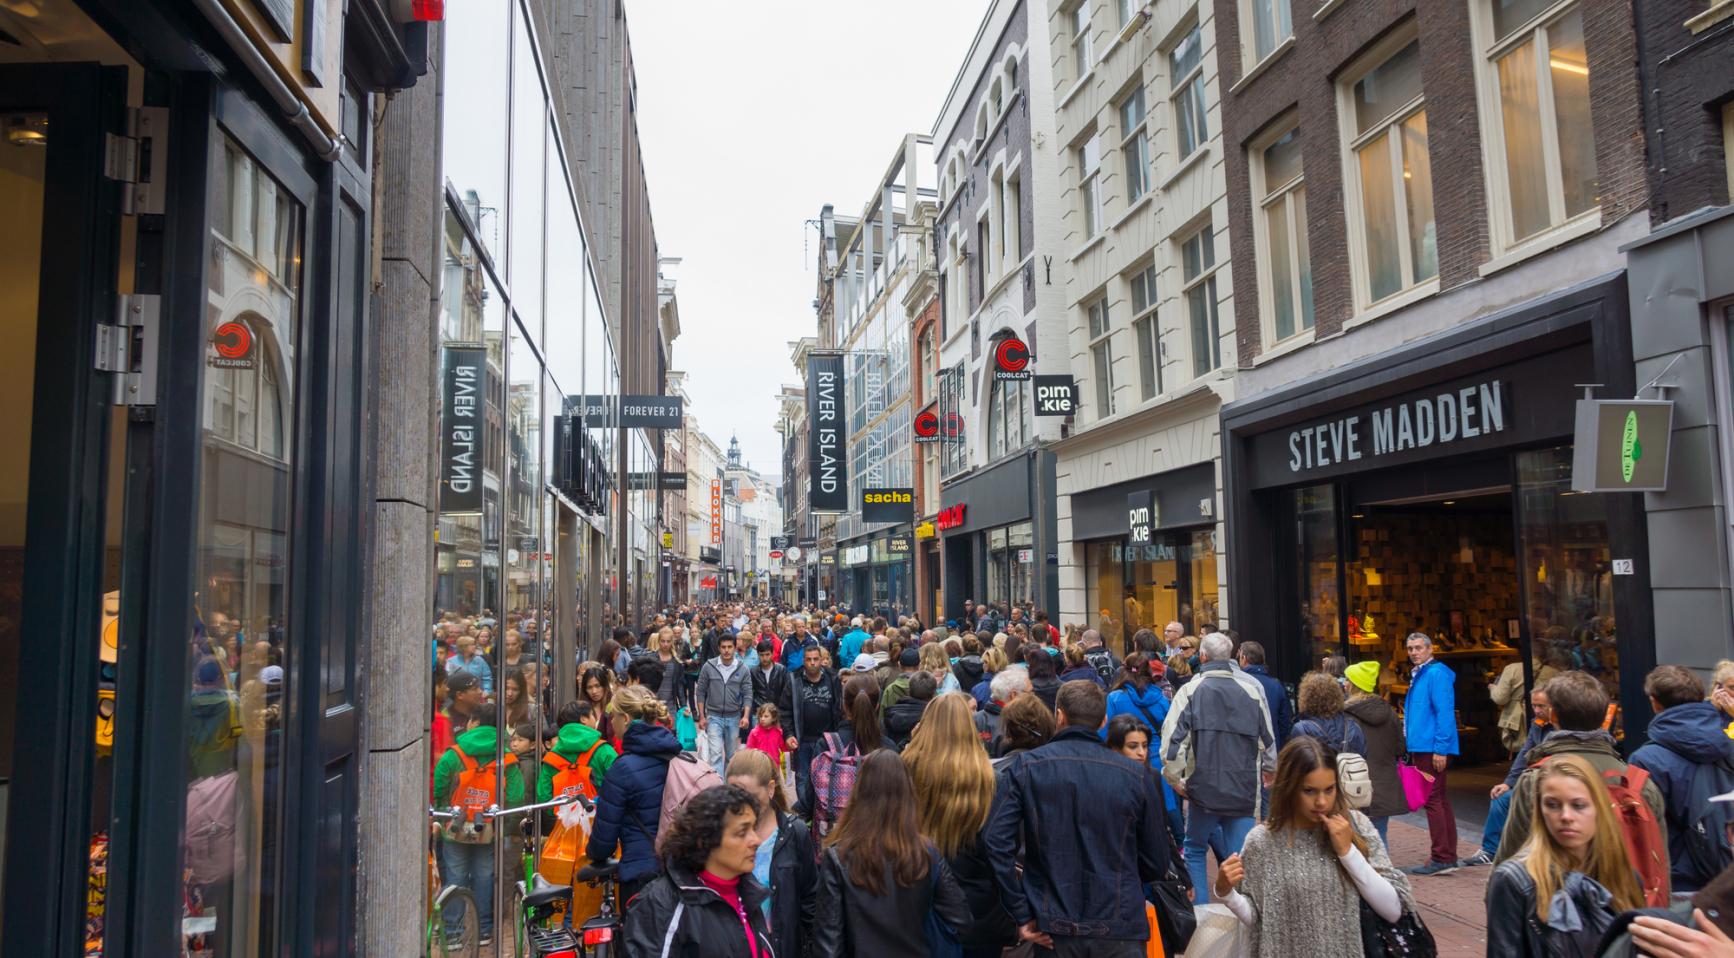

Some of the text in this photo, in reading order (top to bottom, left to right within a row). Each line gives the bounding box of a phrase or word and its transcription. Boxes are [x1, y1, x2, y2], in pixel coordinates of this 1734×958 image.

[1037, 386, 1071, 402] pim
[624, 406, 679, 417] FOREVER 21
[818, 371, 837, 493] RIVER ISLAND
[1289, 380, 1504, 472] STEVE MADDEN
[864, 491, 911, 503] sacha
[712, 480, 720, 543] BLOKKER
[1129, 507, 1149, 529] pim
[1617, 561, 1631, 573] 12
